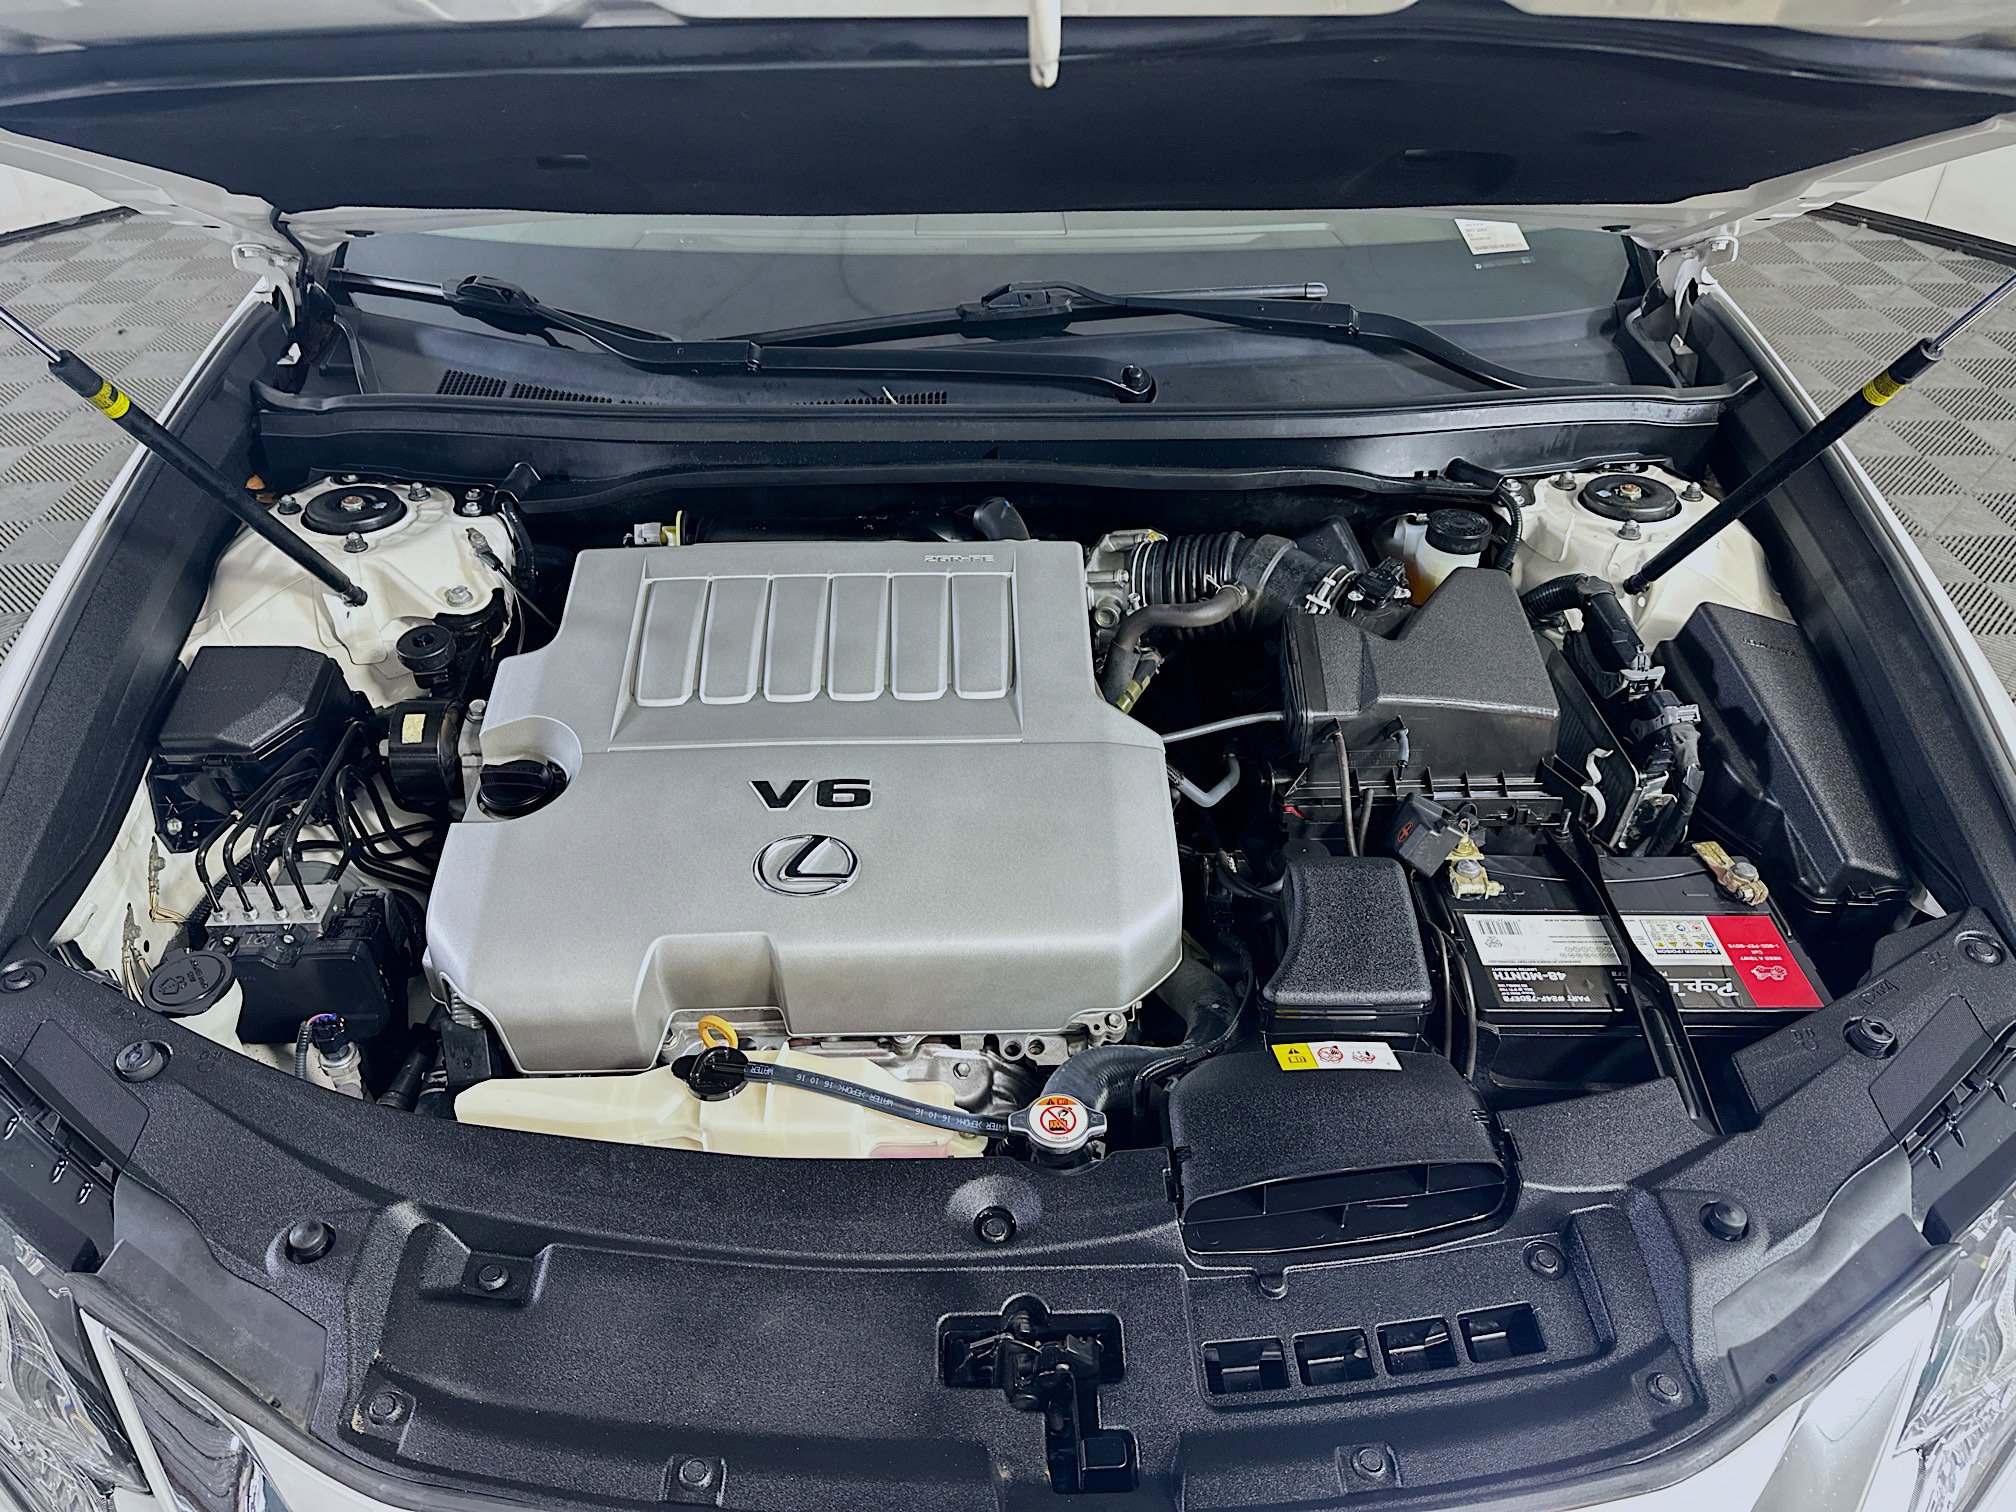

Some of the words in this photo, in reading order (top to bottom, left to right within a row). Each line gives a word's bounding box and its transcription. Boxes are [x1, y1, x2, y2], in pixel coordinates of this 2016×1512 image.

[748, 778, 873, 811] V6
[1492, 971, 1567, 981] 48-MONTH
[1683, 980, 1739, 997] Pep
[750, 1066, 774, 1076] WATER
[796, 1073, 805, 1082] 16
[810, 1077, 819, 1085] 10
[823, 1080, 833, 1089] 16
[869, 1095, 894, 1107] WATER
[915, 1107, 924, 1116] 16
[986, 1124, 1005, 1132] ATER
